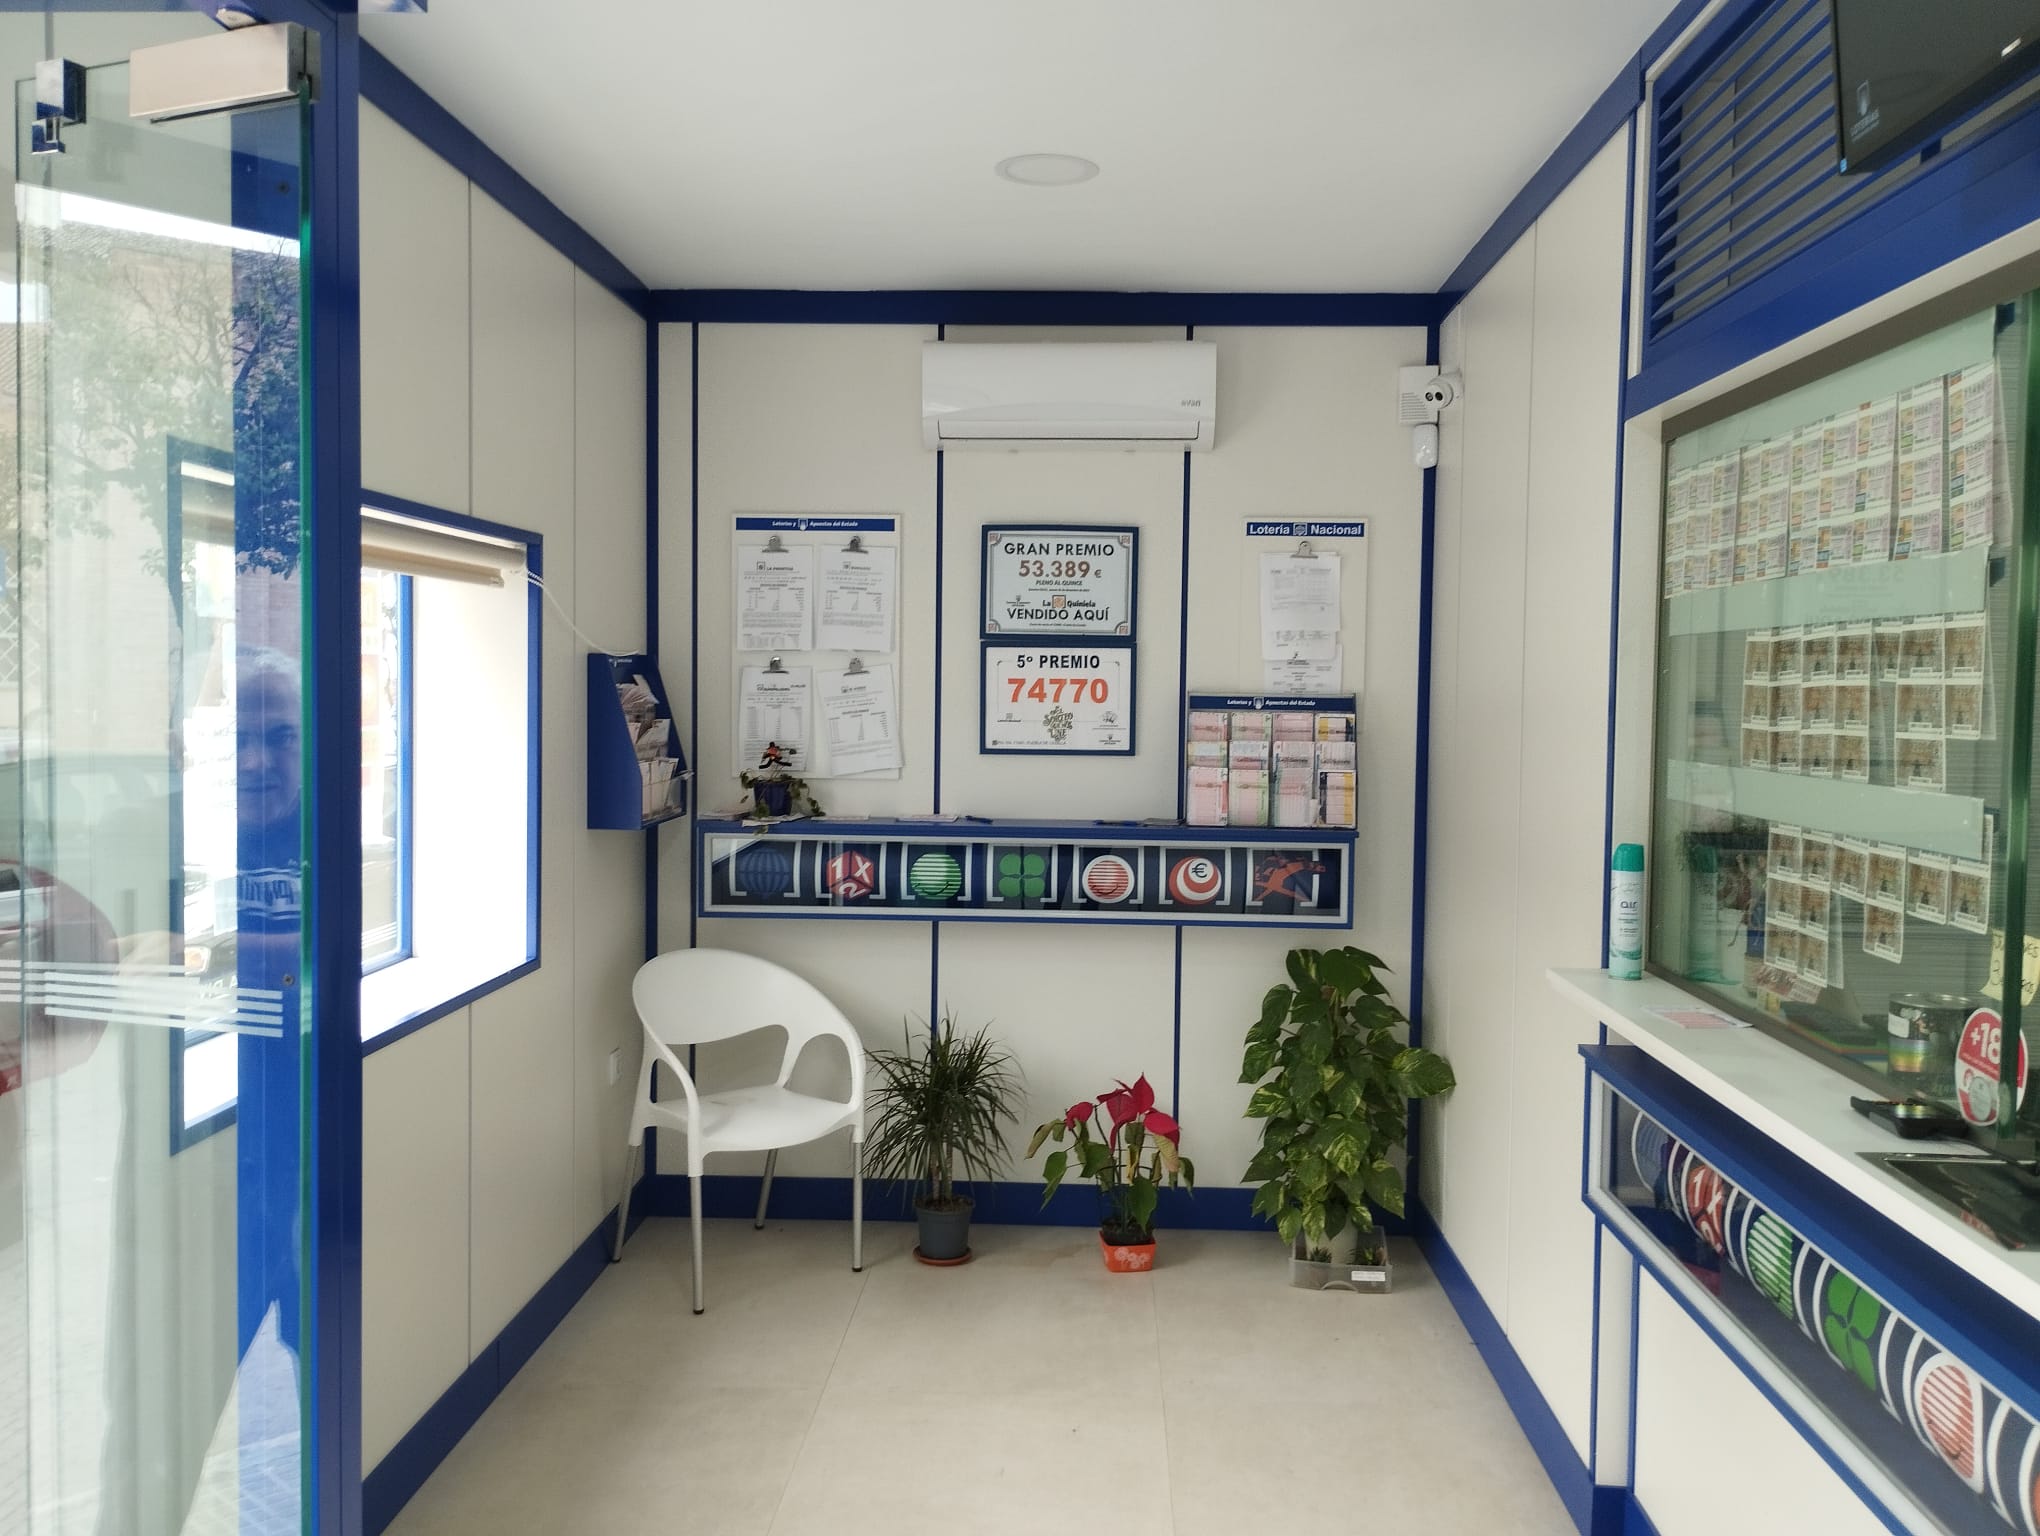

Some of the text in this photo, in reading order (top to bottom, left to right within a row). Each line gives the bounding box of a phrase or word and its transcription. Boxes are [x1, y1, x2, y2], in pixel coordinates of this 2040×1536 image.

[1310, 524, 1362, 535] Nacional
[1004, 543, 1115, 557] GRAN PREMIO
[1018, 560, 1091, 578] 53.389
[1067, 600, 1096, 608] Quiniela
[1007, 607, 1110, 621] VENDIDO AQUÍ
[1040, 655, 1100, 669] PREMIO
[1007, 678, 1109, 704] 74770
[831, 855, 871, 884] 1 X
[1970, 1022, 2001, 1065] +18
